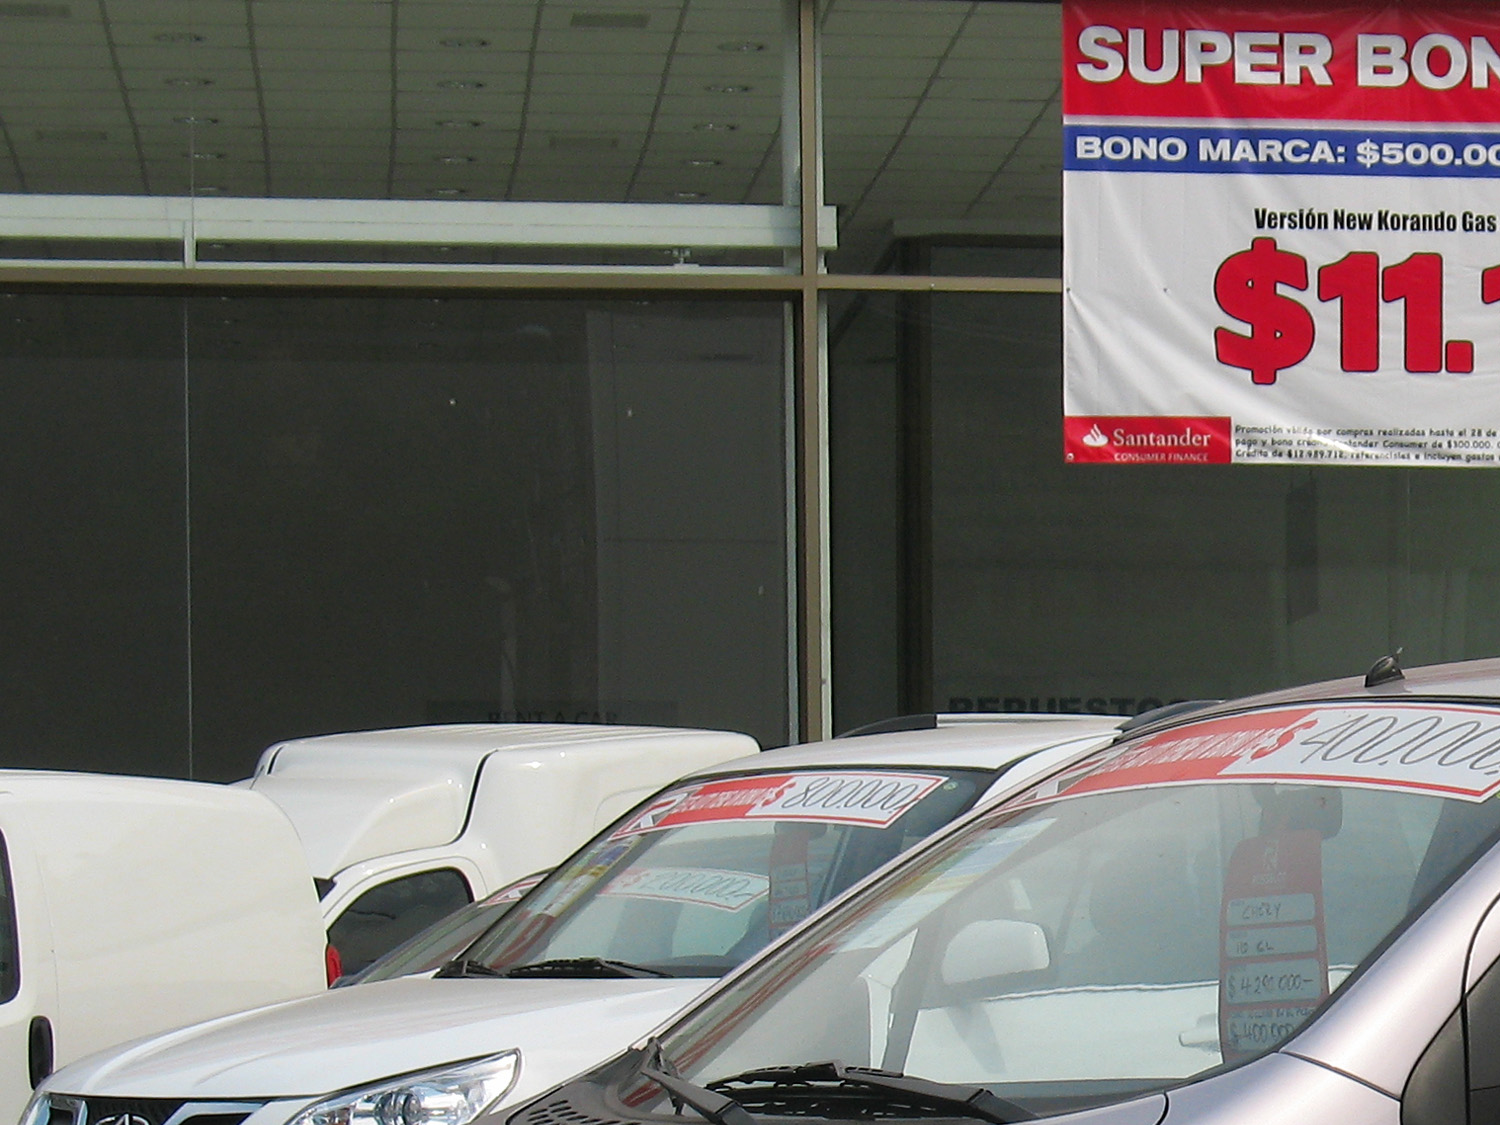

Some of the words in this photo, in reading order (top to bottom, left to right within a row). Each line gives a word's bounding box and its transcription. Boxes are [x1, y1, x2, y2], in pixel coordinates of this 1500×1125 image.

[1075, 25, 1333, 88] SUPER
[1075, 136, 1187, 163] BONO
[1200, 138, 1346, 166] MARCA:
[1254, 207, 1329, 231] Versión
[1334, 209, 1374, 232] New
[1377, 209, 1457, 232] Korando
[1461, 210, 1497, 233] Gas
[1112, 427, 1212, 447] Santander
[1336, 429, 1373, 438] compras
[1378, 427, 1425, 436] realizadas
[1429, 428, 1454, 437] hasta
[1383, 439, 1427, 448] Consumer
[1114, 452, 1167, 462] CONSUMER
[1168, 452, 1209, 462] FINANCE
[1466, 452, 1494, 463] gastos
